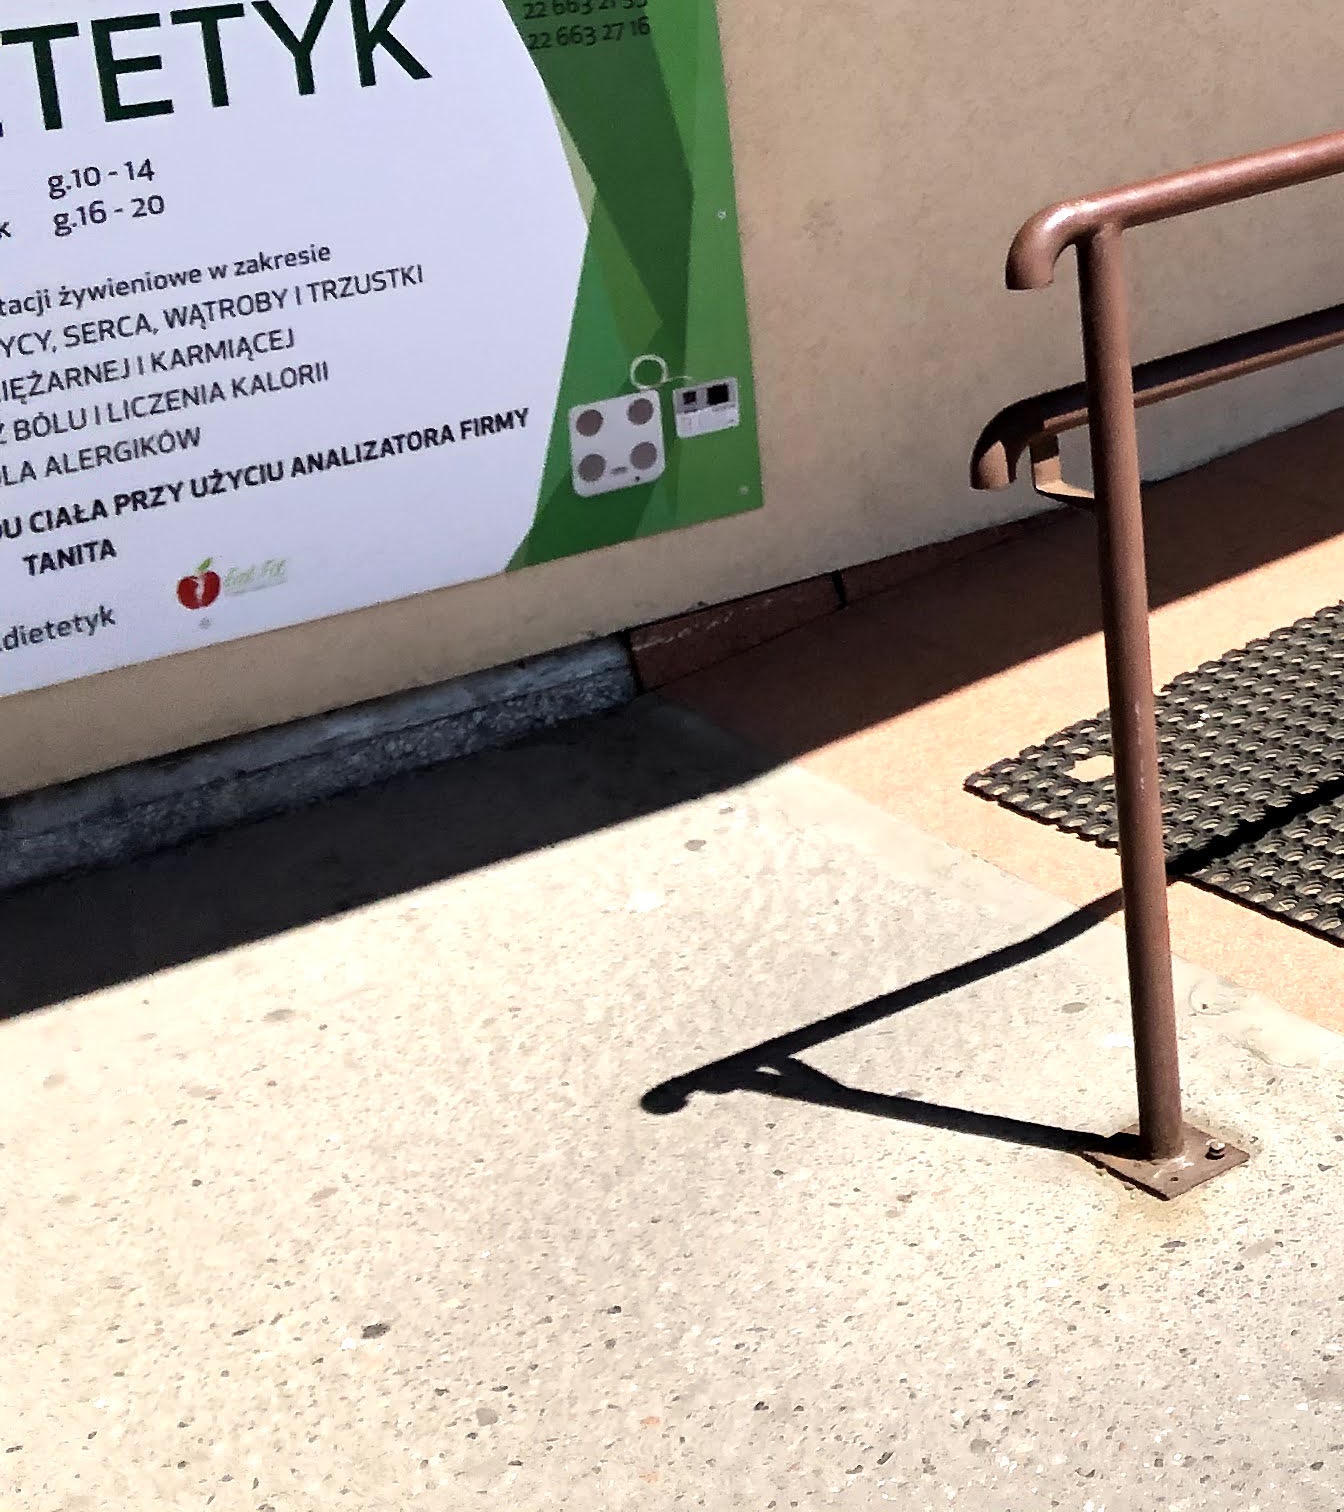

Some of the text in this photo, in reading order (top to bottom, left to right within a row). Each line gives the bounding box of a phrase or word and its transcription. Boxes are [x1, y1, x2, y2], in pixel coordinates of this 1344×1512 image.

[47, 166, 102, 200] g.10
[126, 158, 156, 182] 14
[52, 199, 108, 238] g.16
[130, 194, 165, 219] 20
[58, 266, 202, 311] żywieniowe
[207, 263, 229, 281] w
[233, 243, 332, 278] zakresie
[63, 312, 161, 349] SERCA,
[162, 287, 289, 331] WĄTROBY
[294, 285, 302, 307] I
[306, 263, 425, 305] TRZUSTKI
[0, 327, 295, 405] IĘŻARNEJ I KARMIĄCEJ
[13, 406, 88, 442] BÓLU
[94, 404, 102, 426] I
[107, 380, 228, 425] LICZENIA
[231, 360, 330, 399] KALORII
[0, 459, 38, 487] LA
[44, 425, 202, 479] ALERGIKÓW
[28, 497, 109, 535] CIAŁA
[113, 480, 185, 518] PRZY
[190, 459, 285, 500] UŻYCIU
[290, 423, 457, 479] ANALIZATORA
[459, 406, 530, 442] FIRMY
[23, 537, 119, 578] TANITA
[0, 604, 118, 653] dietetyk
